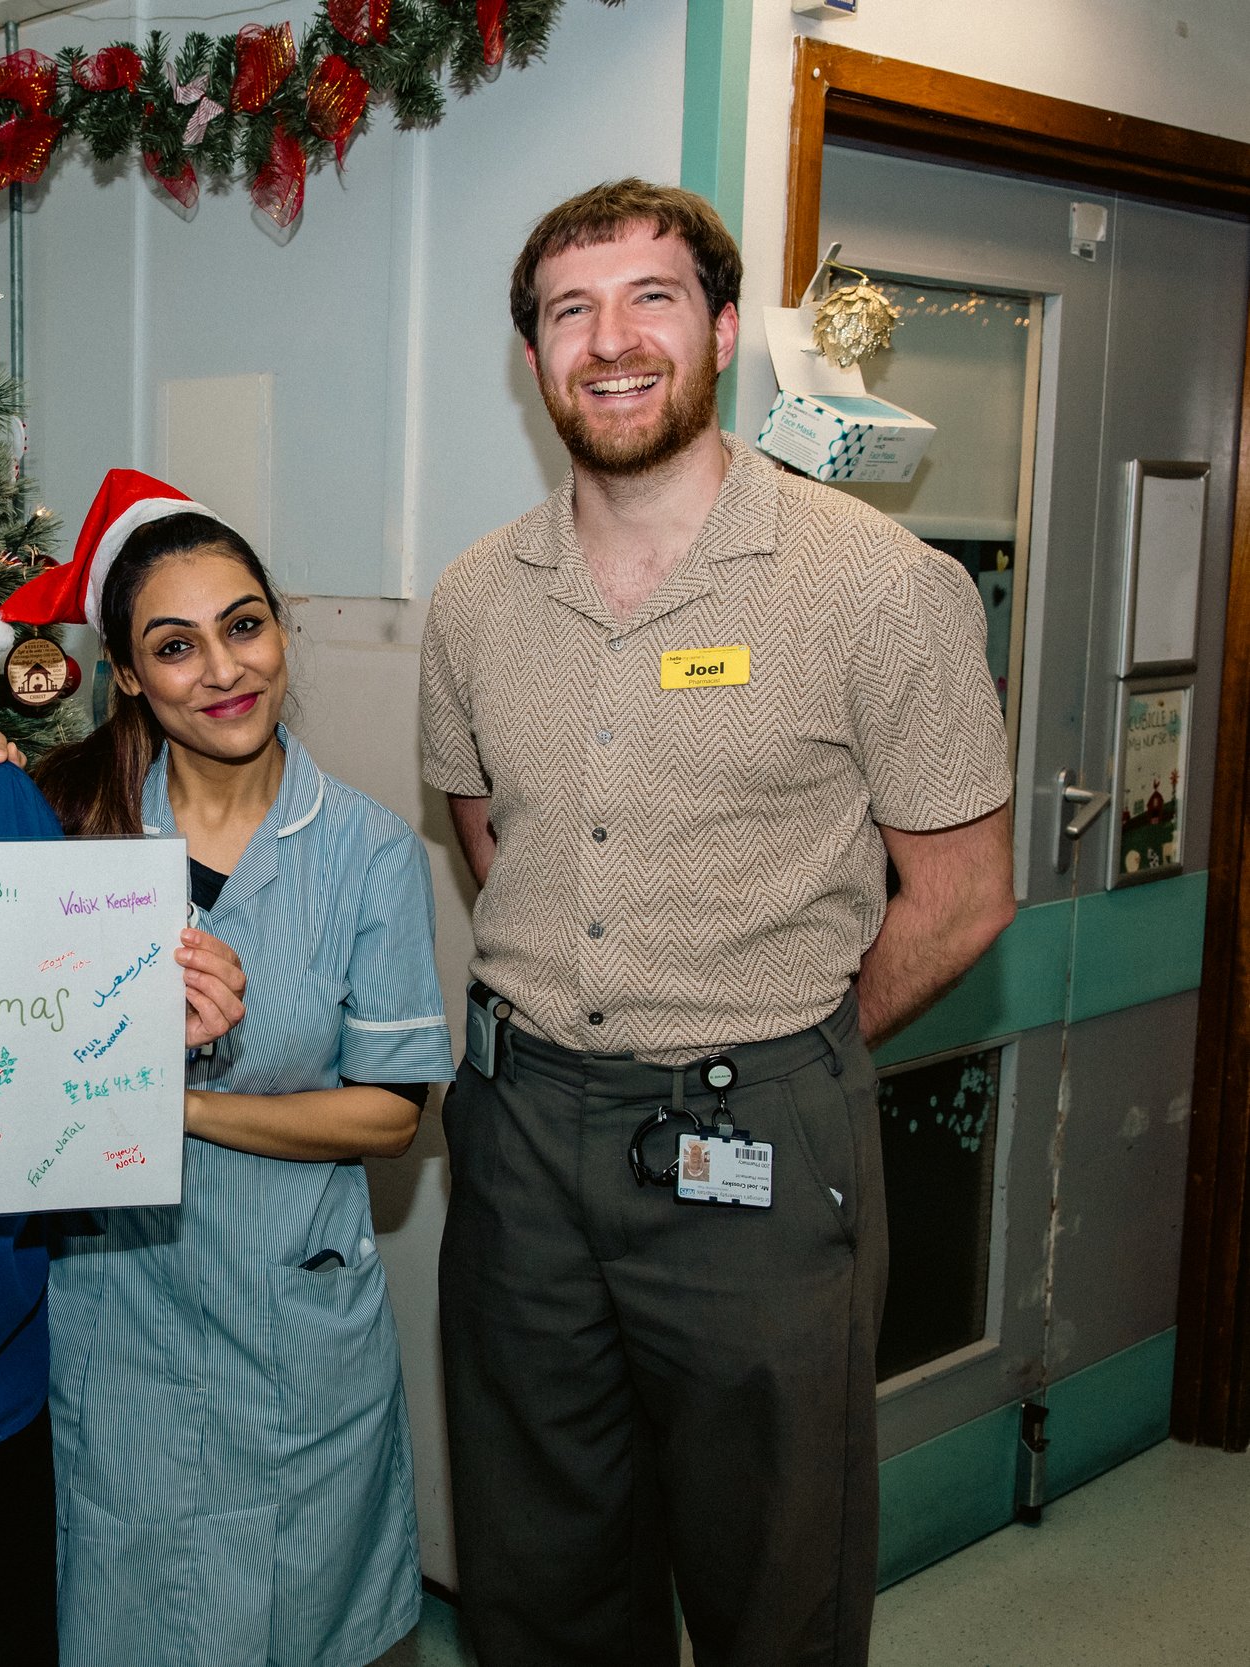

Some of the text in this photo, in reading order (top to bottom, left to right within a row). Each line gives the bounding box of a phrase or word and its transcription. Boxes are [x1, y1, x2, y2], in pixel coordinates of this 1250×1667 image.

[781, 415, 817, 439] Face Masks
[685, 662, 724, 676] Joel
[105, 888, 157, 914] Kerstfeest!
[721, 1180, 746, 1189] Crosskey
[680, 1188, 696, 1196] NHS
